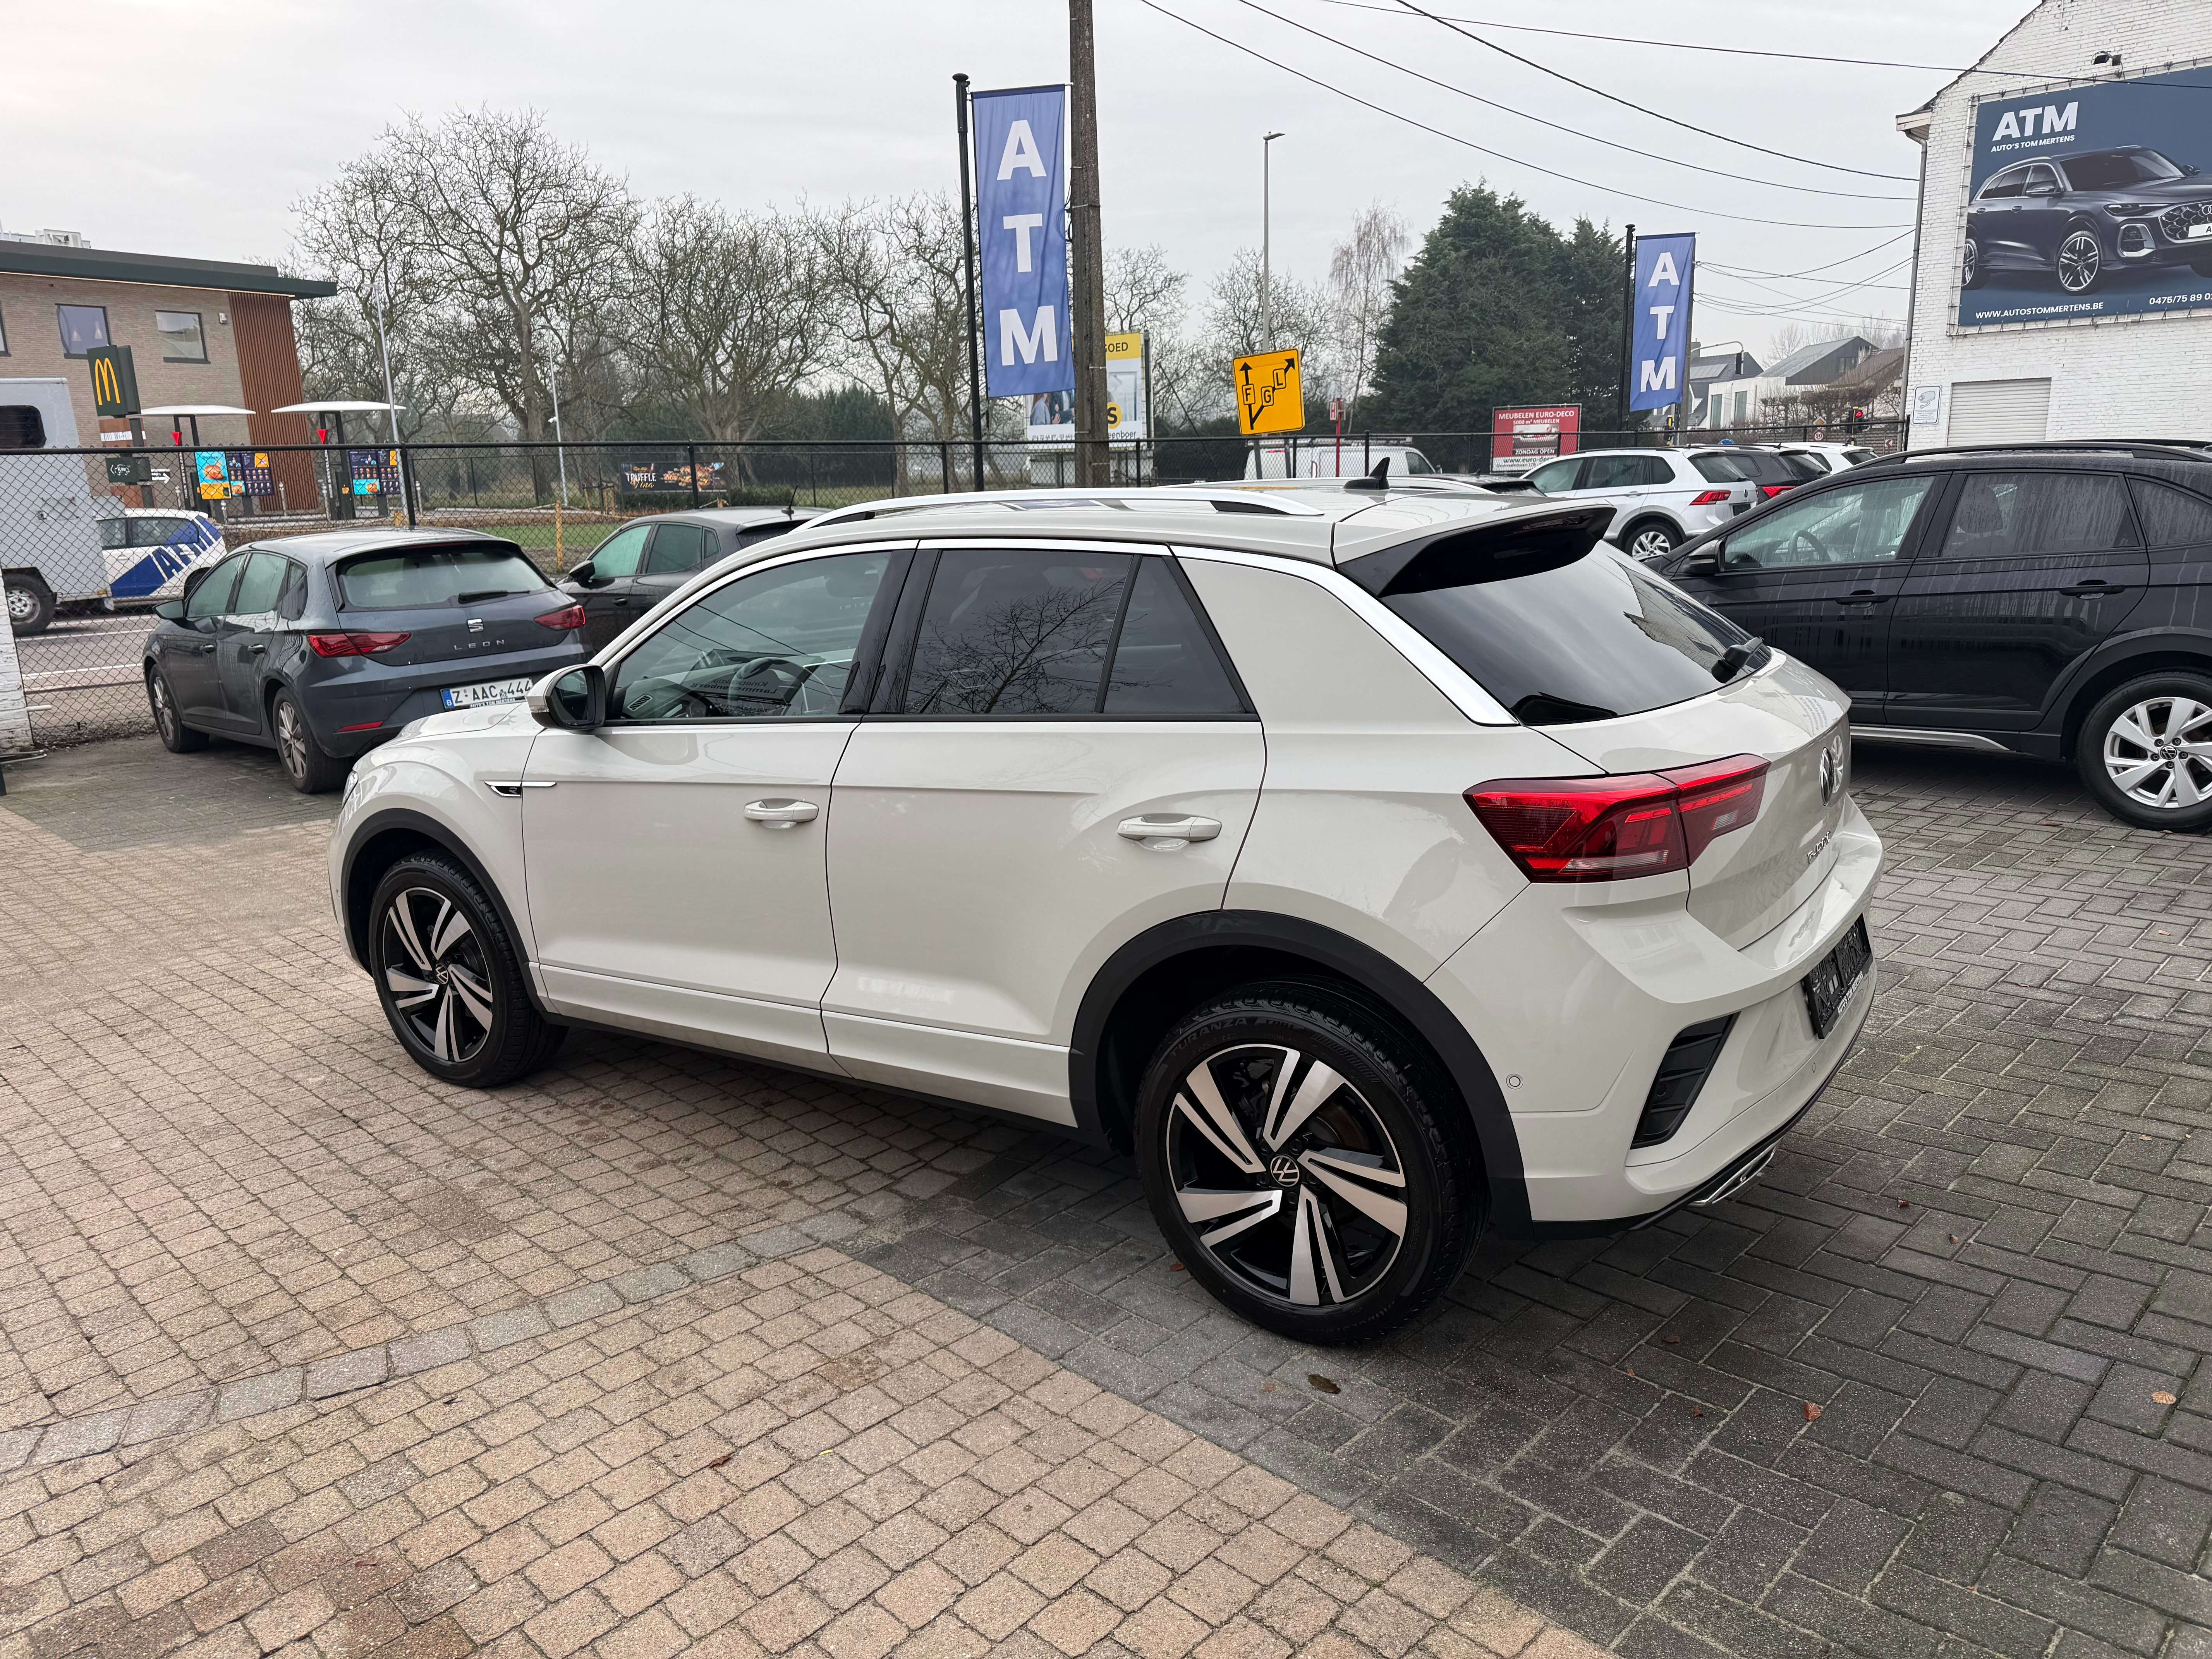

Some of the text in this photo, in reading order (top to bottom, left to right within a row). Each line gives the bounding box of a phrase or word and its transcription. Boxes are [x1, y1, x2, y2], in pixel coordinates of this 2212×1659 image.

[1992, 101, 2078, 141] ATM
[1991, 135, 2075, 152] AUTO'S TOM MERTENS
[1975, 302, 2104, 319] WWW.AUTOSTOMMERTENS.BE
[2149, 295, 2188, 305] 0475/75
[2190, 294, 2202, 302] 89
[1105, 342, 1128, 353] OED
[1276, 372, 1283, 386] L
[1245, 387, 1252, 402] F
[1264, 389, 1271, 404] G
[624, 472, 657, 482] TRUFFLE
[454, 639, 505, 650] LEON
